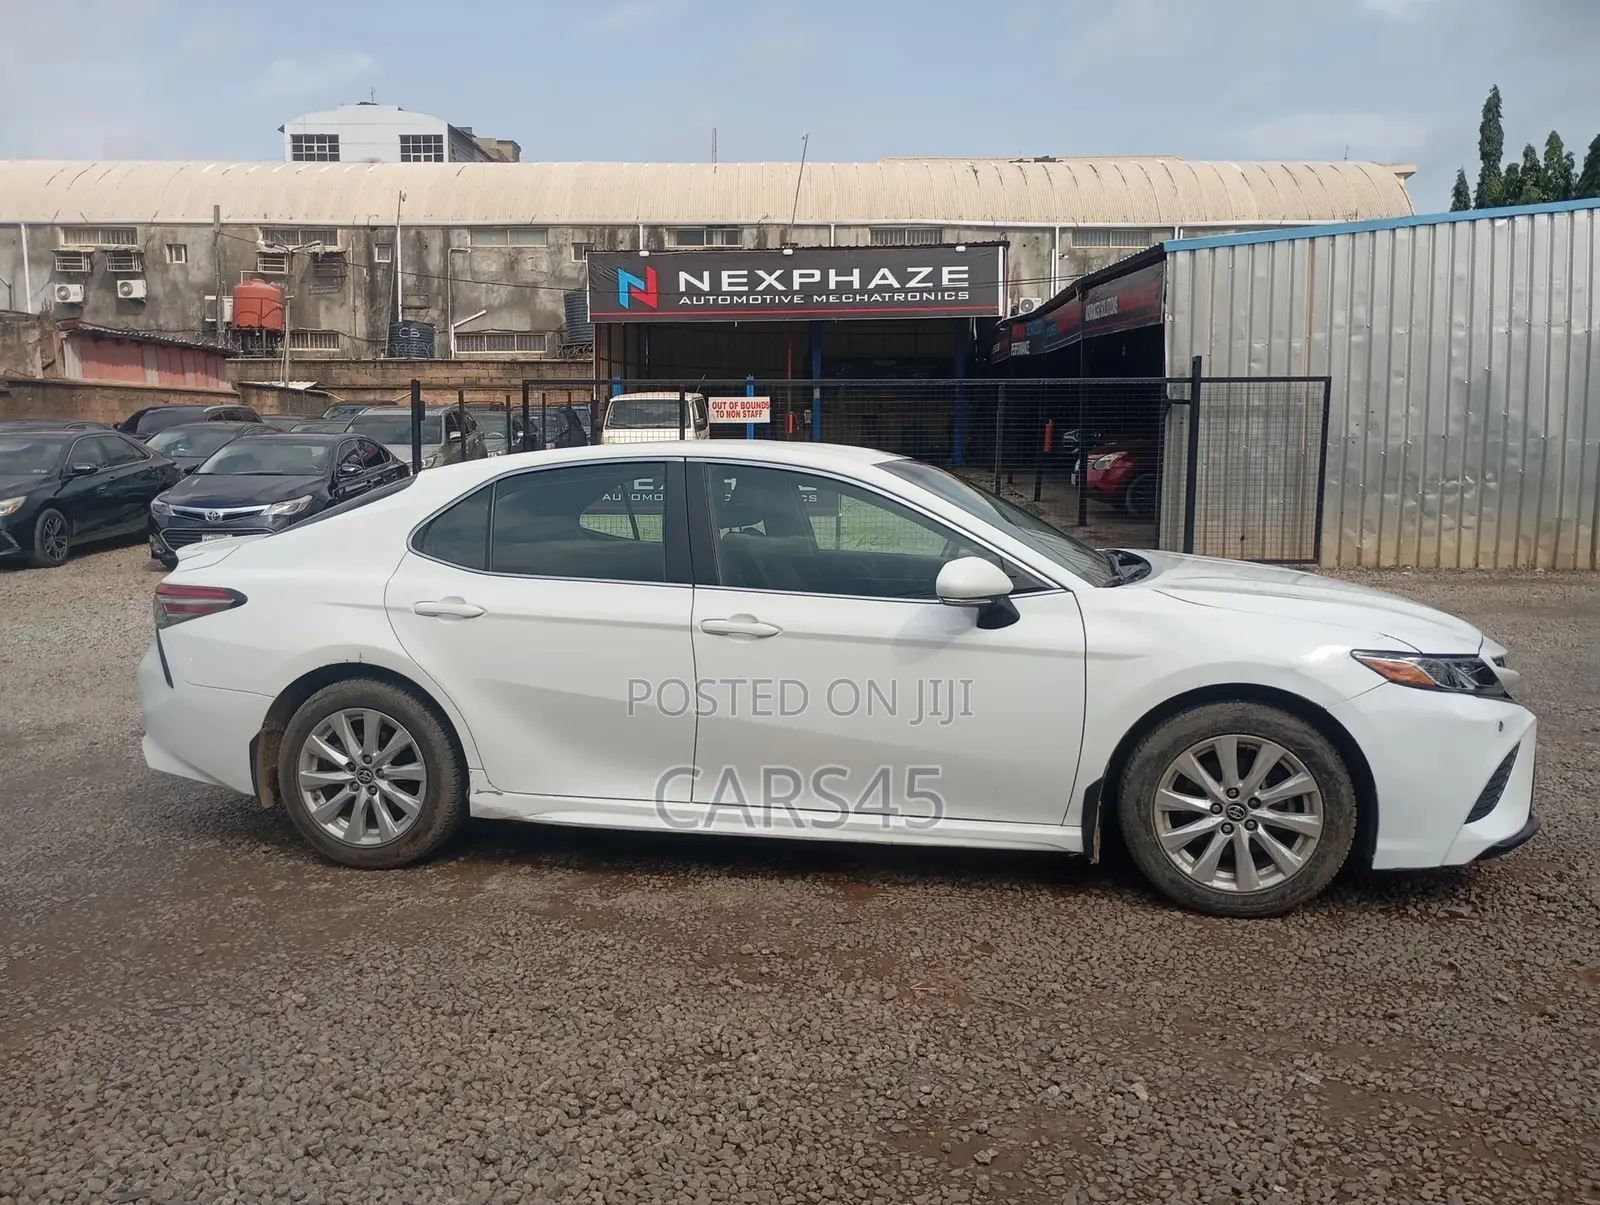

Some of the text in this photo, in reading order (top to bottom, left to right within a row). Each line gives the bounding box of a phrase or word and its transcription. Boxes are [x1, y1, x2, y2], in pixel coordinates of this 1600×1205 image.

[678, 265, 970, 292] NEXPHAZE
[678, 291, 969, 305] AUTOMOTIVE MECHATRONICS
[712, 401, 770, 409] OUT OF BOUNDS
[716, 410, 763, 418] TO NON STAFF
